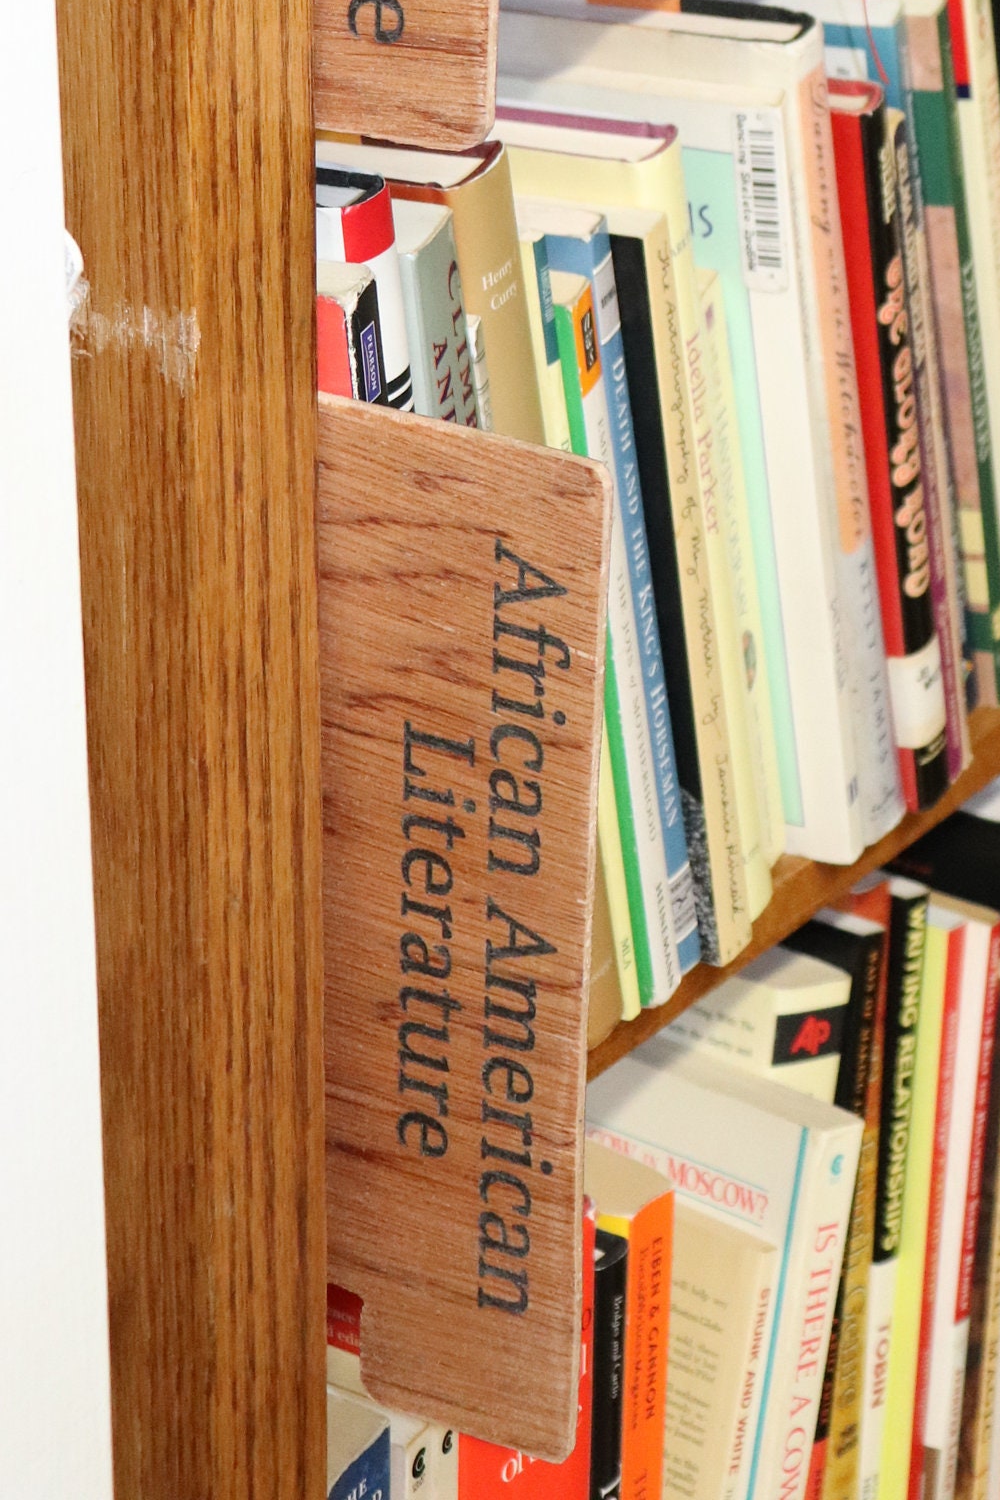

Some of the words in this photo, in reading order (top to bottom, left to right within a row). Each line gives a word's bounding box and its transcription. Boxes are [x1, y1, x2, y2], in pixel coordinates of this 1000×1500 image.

[736, 113, 749, 166] Dancing
[810, 82, 834, 236] Dancing
[482, 259, 513, 291] Henry
[365, 333, 377, 391] PEARSON
[663, 299, 691, 485] Autobiography
[685, 329, 707, 424] Idella
[611, 355, 632, 451] DEATH
[623, 461, 643, 516] AND
[695, 427, 721, 536] Parker
[632, 525, 652, 579] THE
[615, 572, 630, 610] THE
[618, 618, 636, 667] JOYS
[638, 583, 664, 678] KING'S
[488, 537, 572, 877] African
[631, 698, 659, 843] MOTHERHOOD
[649, 686, 681, 830] HORSEMAN
[398, 719, 477, 1159] Literature
[619, 938, 632, 971] MLA
[653, 882, 677, 990] HEINEMANN
[897, 901, 929, 1028] WRITING
[476, 896, 559, 1317] American
[880, 1035, 919, 1254] RELATIONSHIPS
[667, 1156, 770, 1220] MOSCOW?
[649, 1236, 664, 1298] EIBEN
[813, 1222, 839, 1253] IS
[610, 1295, 624, 1338] Bridges
[647, 1305, 661, 1319] &
[748, 1287, 772, 1363] STRUNK
[794, 1261, 833, 1383] THERE
[610, 1363, 621, 1400] Curtis
[611, 1340, 621, 1362] and
[869, 1321, 892, 1411] TOBIN
[740, 1369, 758, 1410] AND
[789, 1393, 814, 1418] A
[727, 1416, 748, 1478] WHITE
